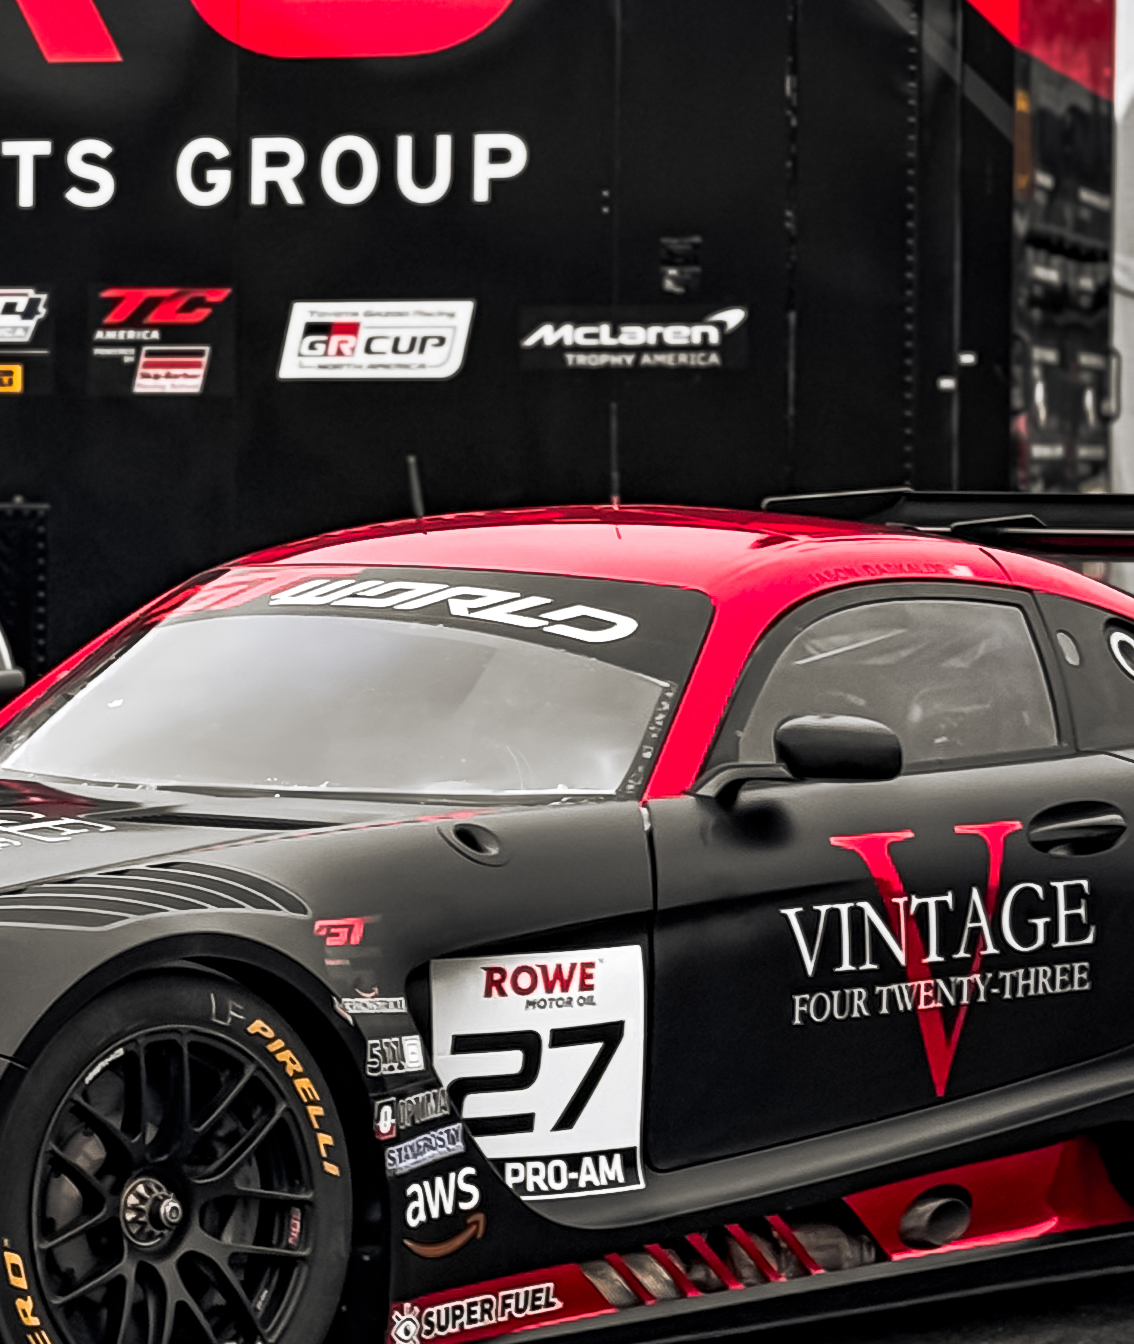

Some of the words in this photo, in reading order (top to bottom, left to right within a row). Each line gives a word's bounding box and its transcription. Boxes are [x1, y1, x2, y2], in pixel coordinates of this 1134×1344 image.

[176, 132, 530, 210] GROUP
[99, 287, 233, 324] TC
[93, 329, 160, 340] AMERICA
[299, 334, 358, 357] GR
[363, 335, 447, 355] CUP
[521, 323, 721, 347] McLaren
[566, 353, 636, 367] TROPHY
[639, 352, 722, 366] AMERICA
[268, 579, 640, 643] WORLD
[780, 878, 1097, 978] VINTAGE
[480, 961, 596, 998] ROWE
[524, 997, 574, 1010] MOTOR
[576, 995, 597, 1007] OIL
[791, 985, 870, 1027] FOUR
[875, 961, 1093, 1017] TWENTY-THREE
[246, 1019, 342, 1178] PIRELLI
[448, 1020, 626, 1137] 27
[505, 1153, 626, 1192] PRO-AM
[405, 1166, 481, 1228] aws
[422, 1295, 497, 1339] SUPER
[498, 1283, 560, 1321] FUEL
